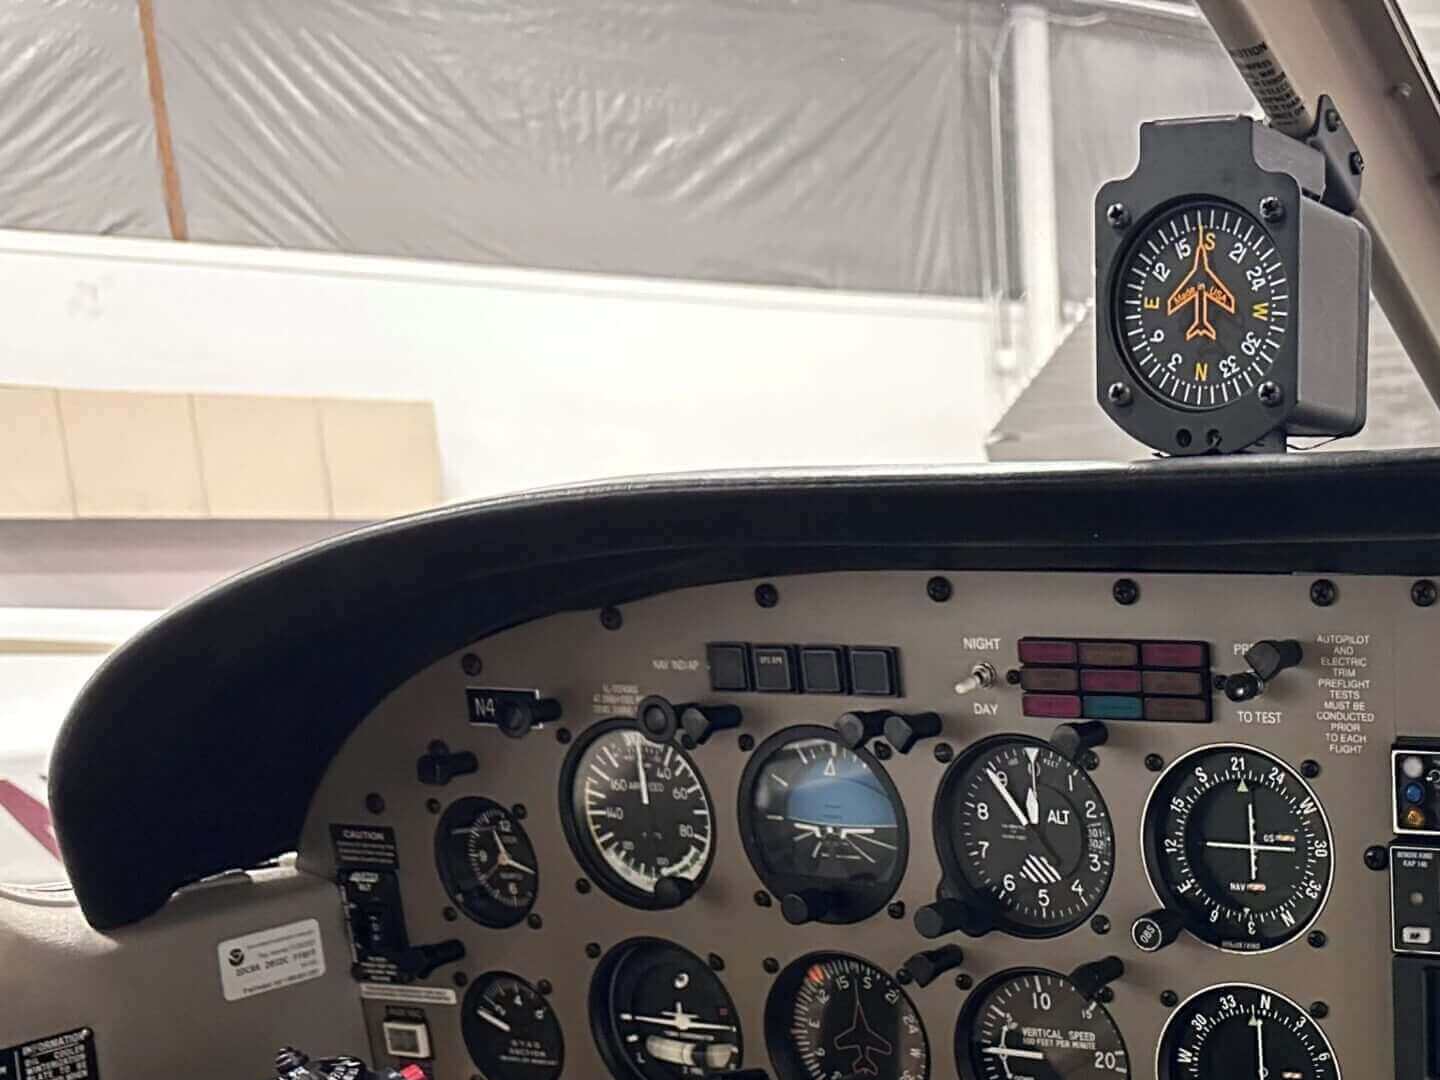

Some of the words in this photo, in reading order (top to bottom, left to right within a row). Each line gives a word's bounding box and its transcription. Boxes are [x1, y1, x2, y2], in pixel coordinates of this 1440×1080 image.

[1205, 232, 1216, 250] S
[1174, 239, 1191, 260] 15
[1229, 242, 1247, 264] 21
[1152, 262, 1171, 282] 12
[1246, 266, 1266, 291] 24
[1241, 331, 1261, 354] 30
[1195, 363, 1207, 381] N
[1219, 355, 1240, 377] 33
[963, 638, 1000, 650] NIGHT
[1316, 635, 1369, 644] AUTOPILOT
[1334, 647, 1353, 655] AND
[1321, 657, 1367, 666] ELECTRIC
[1333, 668, 1356, 676] TRIM
[1319, 679, 1369, 688] PREFLIGHT
[1329, 690, 1360, 699] TESTS
[973, 703, 998, 716] DAY
[1324, 701, 1350, 710] MUST
[1237, 711, 1252, 723] TO
[1255, 712, 1281, 723] TEST
[1316, 712, 1374, 721] CONDUCTED
[1331, 723, 1360, 732] PRIOR
[1326, 733, 1338, 742] TO
[1340, 734, 1366, 743] EACH
[1330, 744, 1362, 753] FLIGHT
[1231, 757, 1245, 770] 21
[1269, 768, 1285, 784] 24
[673, 787, 688, 799] 60
[1170, 797, 1184, 813] 15
[1048, 810, 1070, 824] ALT
[343, 829, 385, 841] CAUTION
[680, 824, 693, 837] 80
[1165, 839, 1177, 854] 12
[1314, 841, 1328, 857] 30
[1305, 880, 1321, 899] 33
[1140, 925, 1155, 943] OBS
[1033, 992, 1051, 1010] 10
[1219, 995, 1237, 1010] 33
[1260, 995, 1271, 1009] N
[1191, 1014, 1208, 1031] 30
[1022, 1028, 1062, 1039] VERTICAL
[1069, 1030, 1095, 1041] SPEED
[1056, 1040, 1070, 1048] PER
[1095, 1052, 1115, 1069] 20
